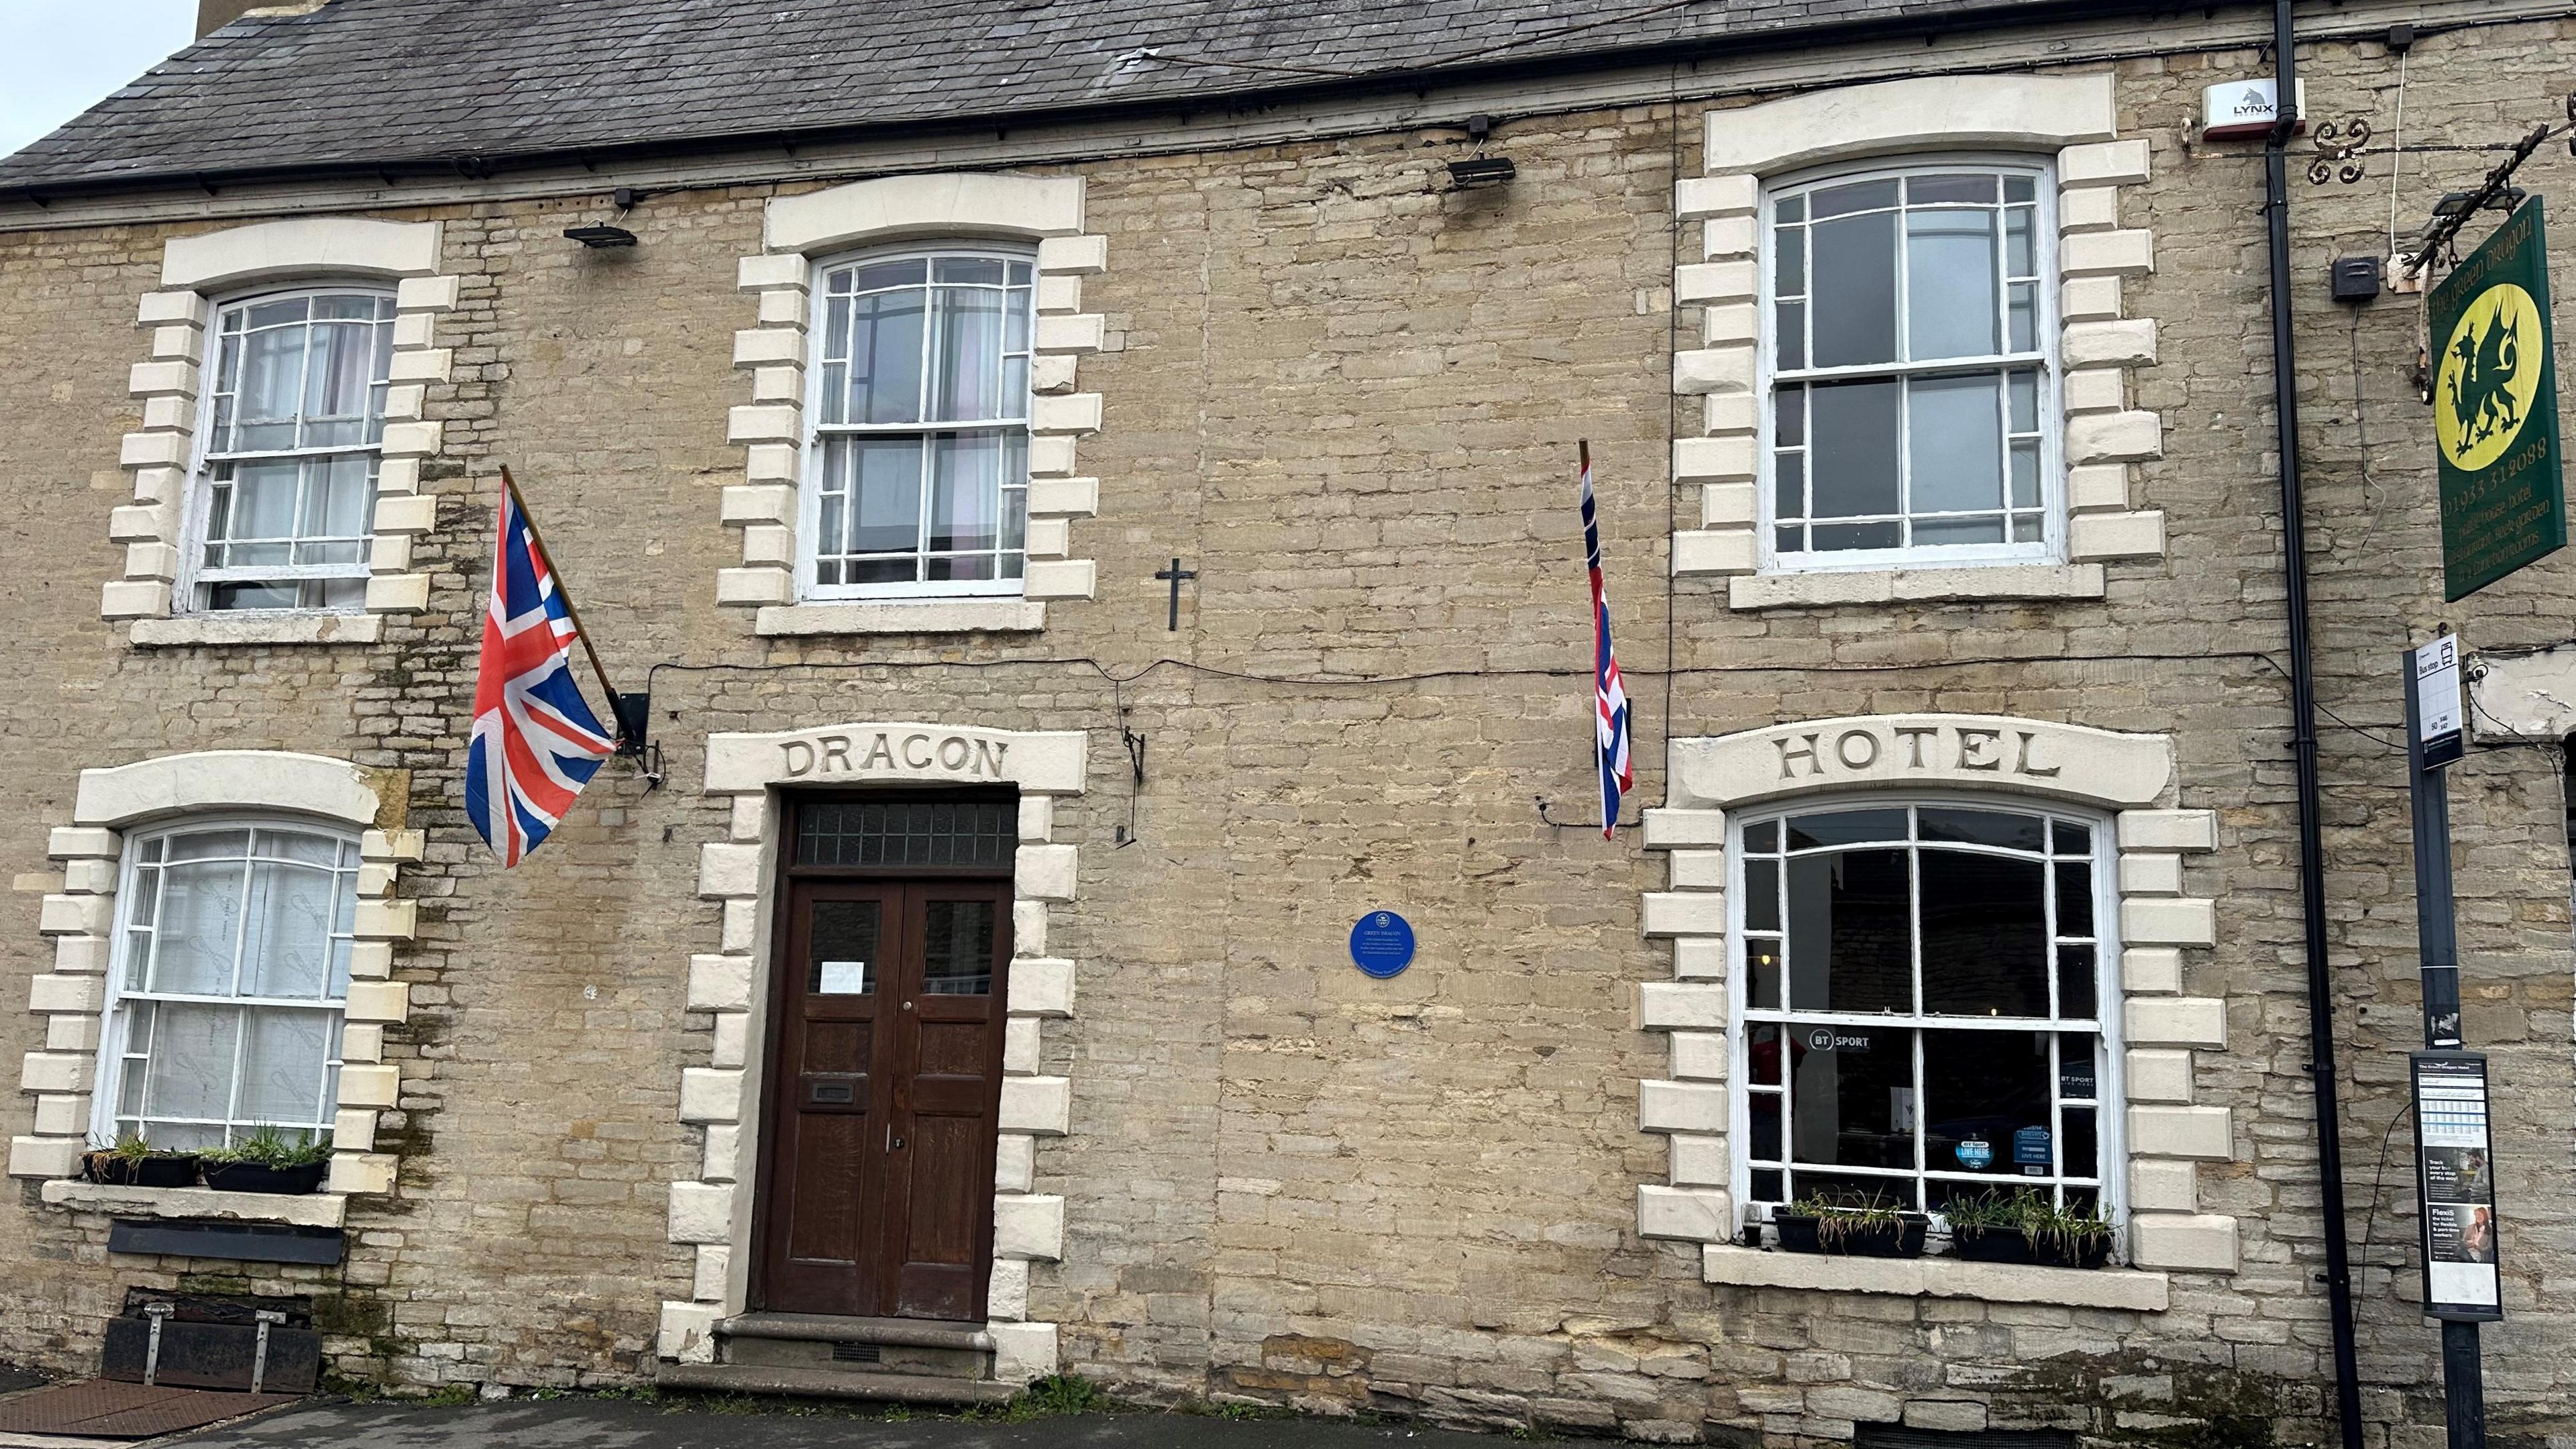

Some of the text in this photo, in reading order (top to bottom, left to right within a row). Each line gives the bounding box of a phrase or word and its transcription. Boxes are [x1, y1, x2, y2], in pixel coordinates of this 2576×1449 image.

[2234, 105, 2273, 113] LYNX
[2443, 437, 2546, 518] 01933 312088
[2419, 661, 2438, 675] Bus stop
[2431, 721, 2438, 731] 50
[778, 733, 1009, 778] DRAGON
[1771, 727, 2061, 779] HOTEL
[1815, 1036, 1869, 1046] BT SPORT
[1961, 1148, 1990, 1157] LIVE HERE
